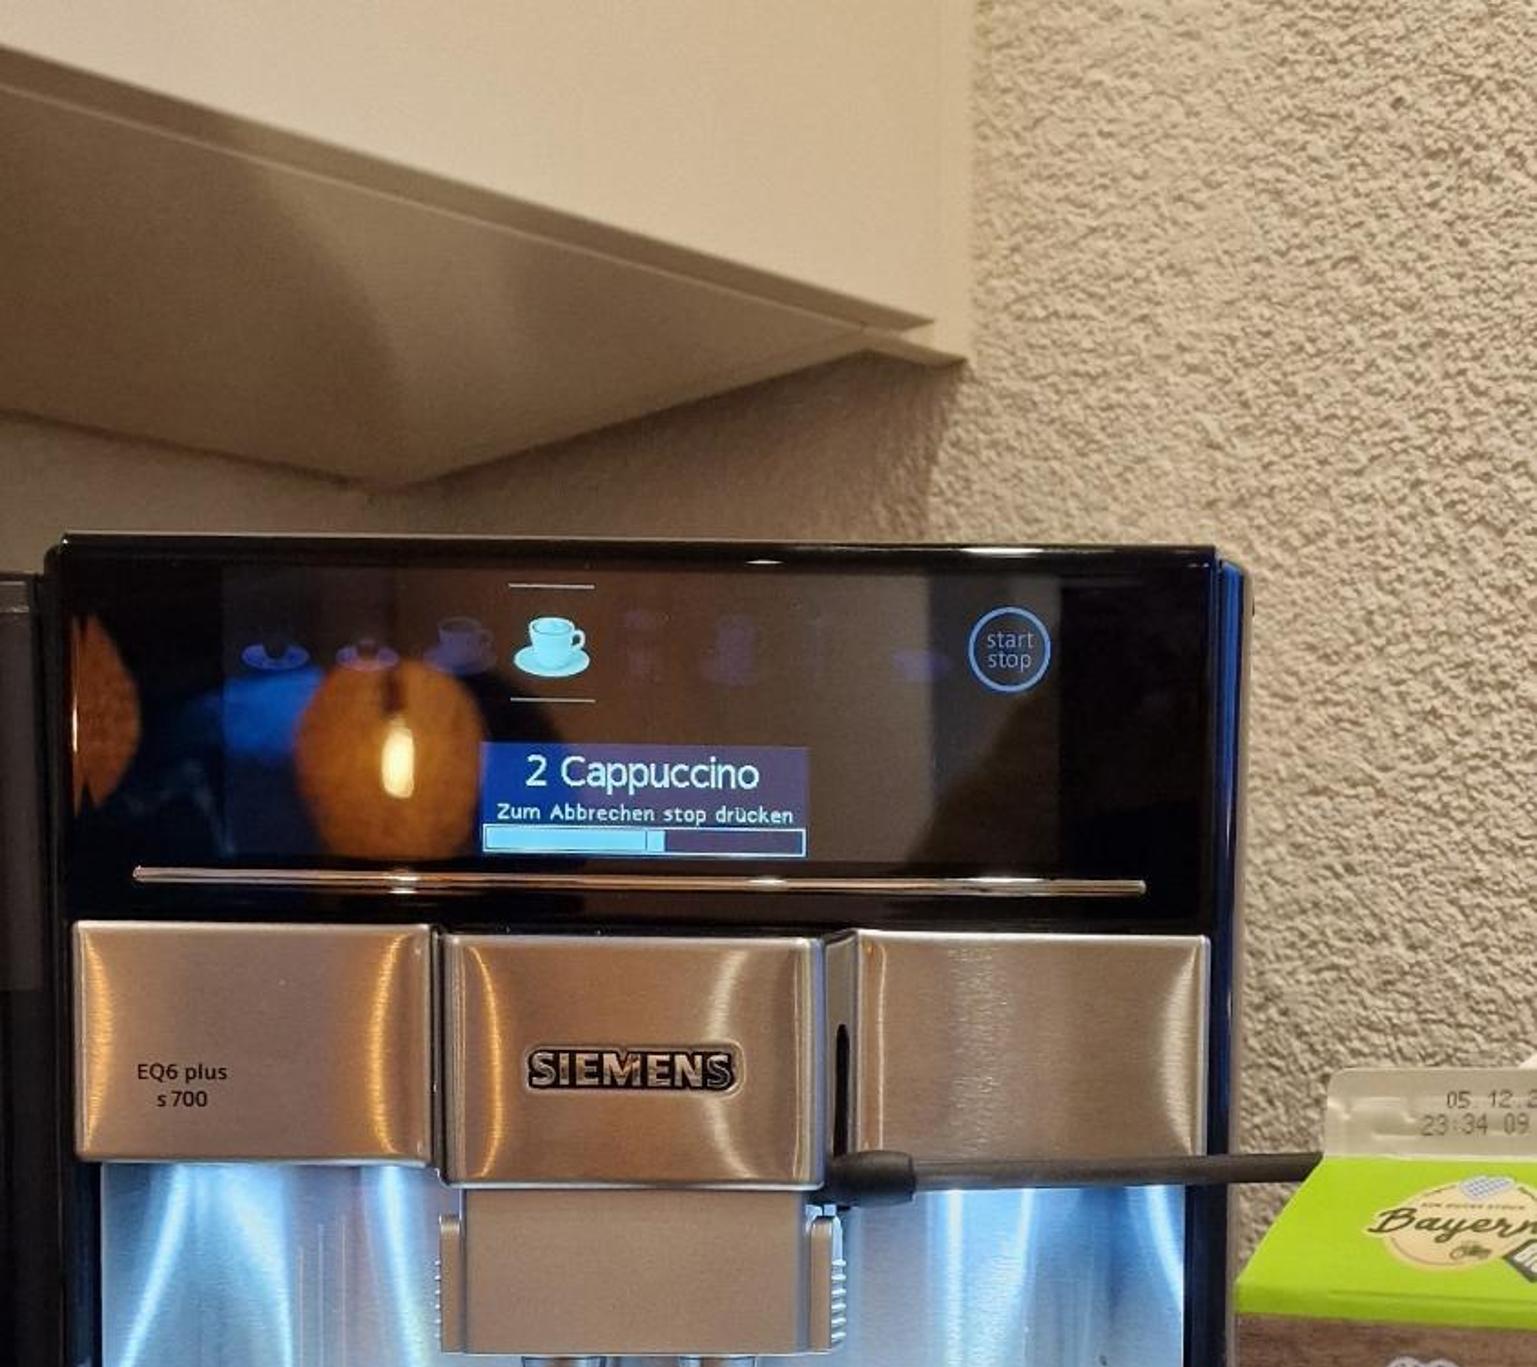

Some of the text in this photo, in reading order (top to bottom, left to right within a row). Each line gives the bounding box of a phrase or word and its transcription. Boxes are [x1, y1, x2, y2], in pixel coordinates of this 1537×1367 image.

[987, 631, 1034, 649] start
[988, 651, 1032, 672] stop
[526, 754, 760, 795] 2 Cappuccino
[497, 803, 793, 826] Zum Abbrechen stop drücken
[137, 1063, 228, 1083] EQ6 plus
[531, 1052, 731, 1088] SIEMENS
[171, 1090, 208, 1107] 700
[1421, 1112, 1530, 1136] 23:34 09
